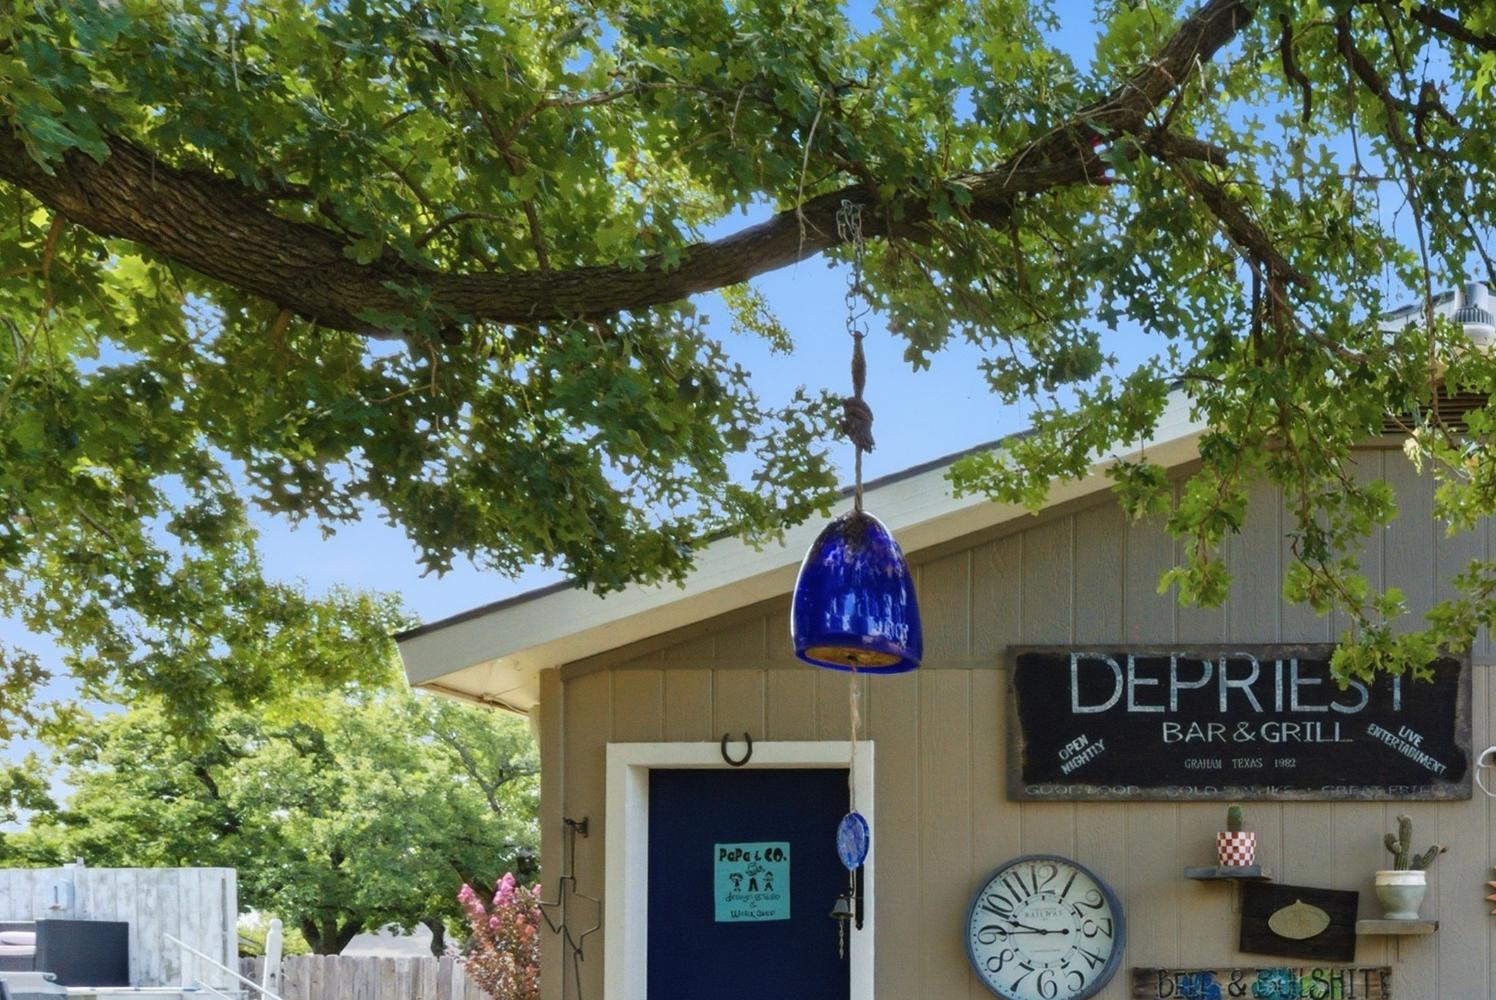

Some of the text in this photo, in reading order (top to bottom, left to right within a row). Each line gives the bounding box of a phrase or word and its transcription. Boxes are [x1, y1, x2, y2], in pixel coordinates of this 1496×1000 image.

[1162, 720, 1354, 743] BAR & GRILL
[1397, 725, 1425, 748] LIVE
[1057, 733, 1089, 761] OPEN
[1060, 738, 1106, 775] NIGHTLY
[1184, 757, 1298, 769] GRAHAM TEXAS 1982
[1086, 784, 1140, 797] OOD
[1001, 871, 1031, 904] 11
[1030, 864, 1058, 895] 12
[1060, 870, 1079, 899] 1
[981, 893, 1014, 920] 10
[1072, 889, 1105, 919] 2
[977, 924, 1008, 945] 9
[1082, 917, 1112, 939] 3
[986, 948, 1015, 973] 8
[1078, 947, 1107, 970] 4
[1010, 961, 1036, 993] 7
[1036, 969, 1058, 1000] 6
[1061, 961, 1085, 993] 5
[1228, 970, 1247, 998] &
